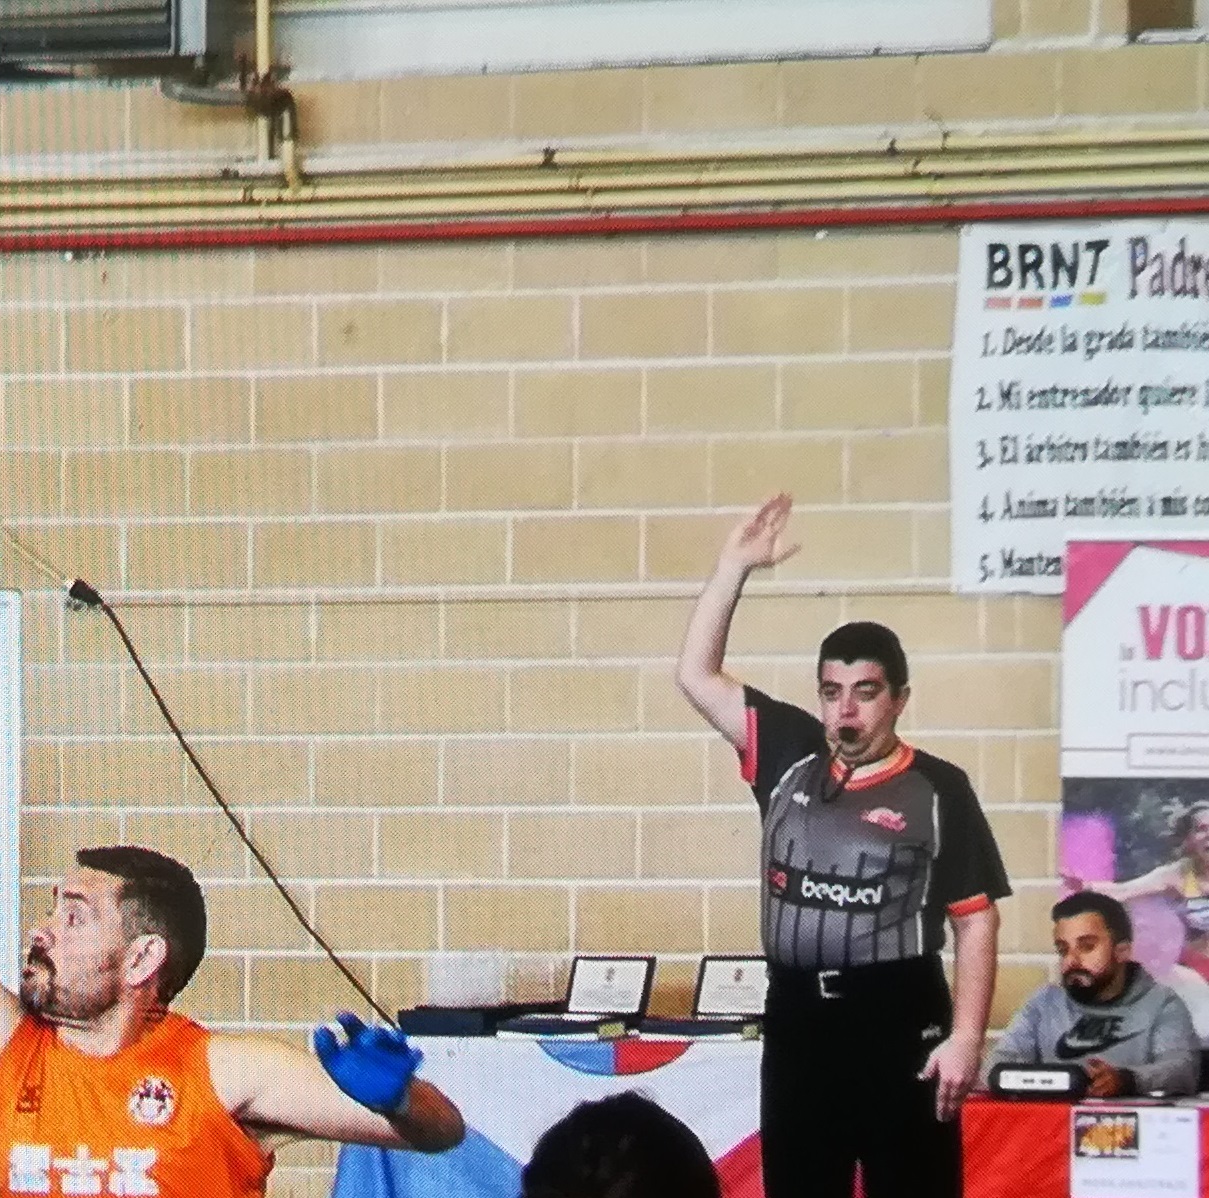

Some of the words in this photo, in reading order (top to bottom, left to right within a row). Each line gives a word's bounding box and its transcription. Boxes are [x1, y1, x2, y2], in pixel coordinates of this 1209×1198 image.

[986, 239, 1110, 289] BRNT
[1001, 325, 1054, 355] Desde
[1083, 321, 1134, 360] grada
[998, 379, 1022, 410] Mi
[1027, 377, 1133, 409] entrenador
[999, 434, 1019, 464] El
[1138, 605, 1209, 662] VO
[801, 875, 884, 907] bequal
